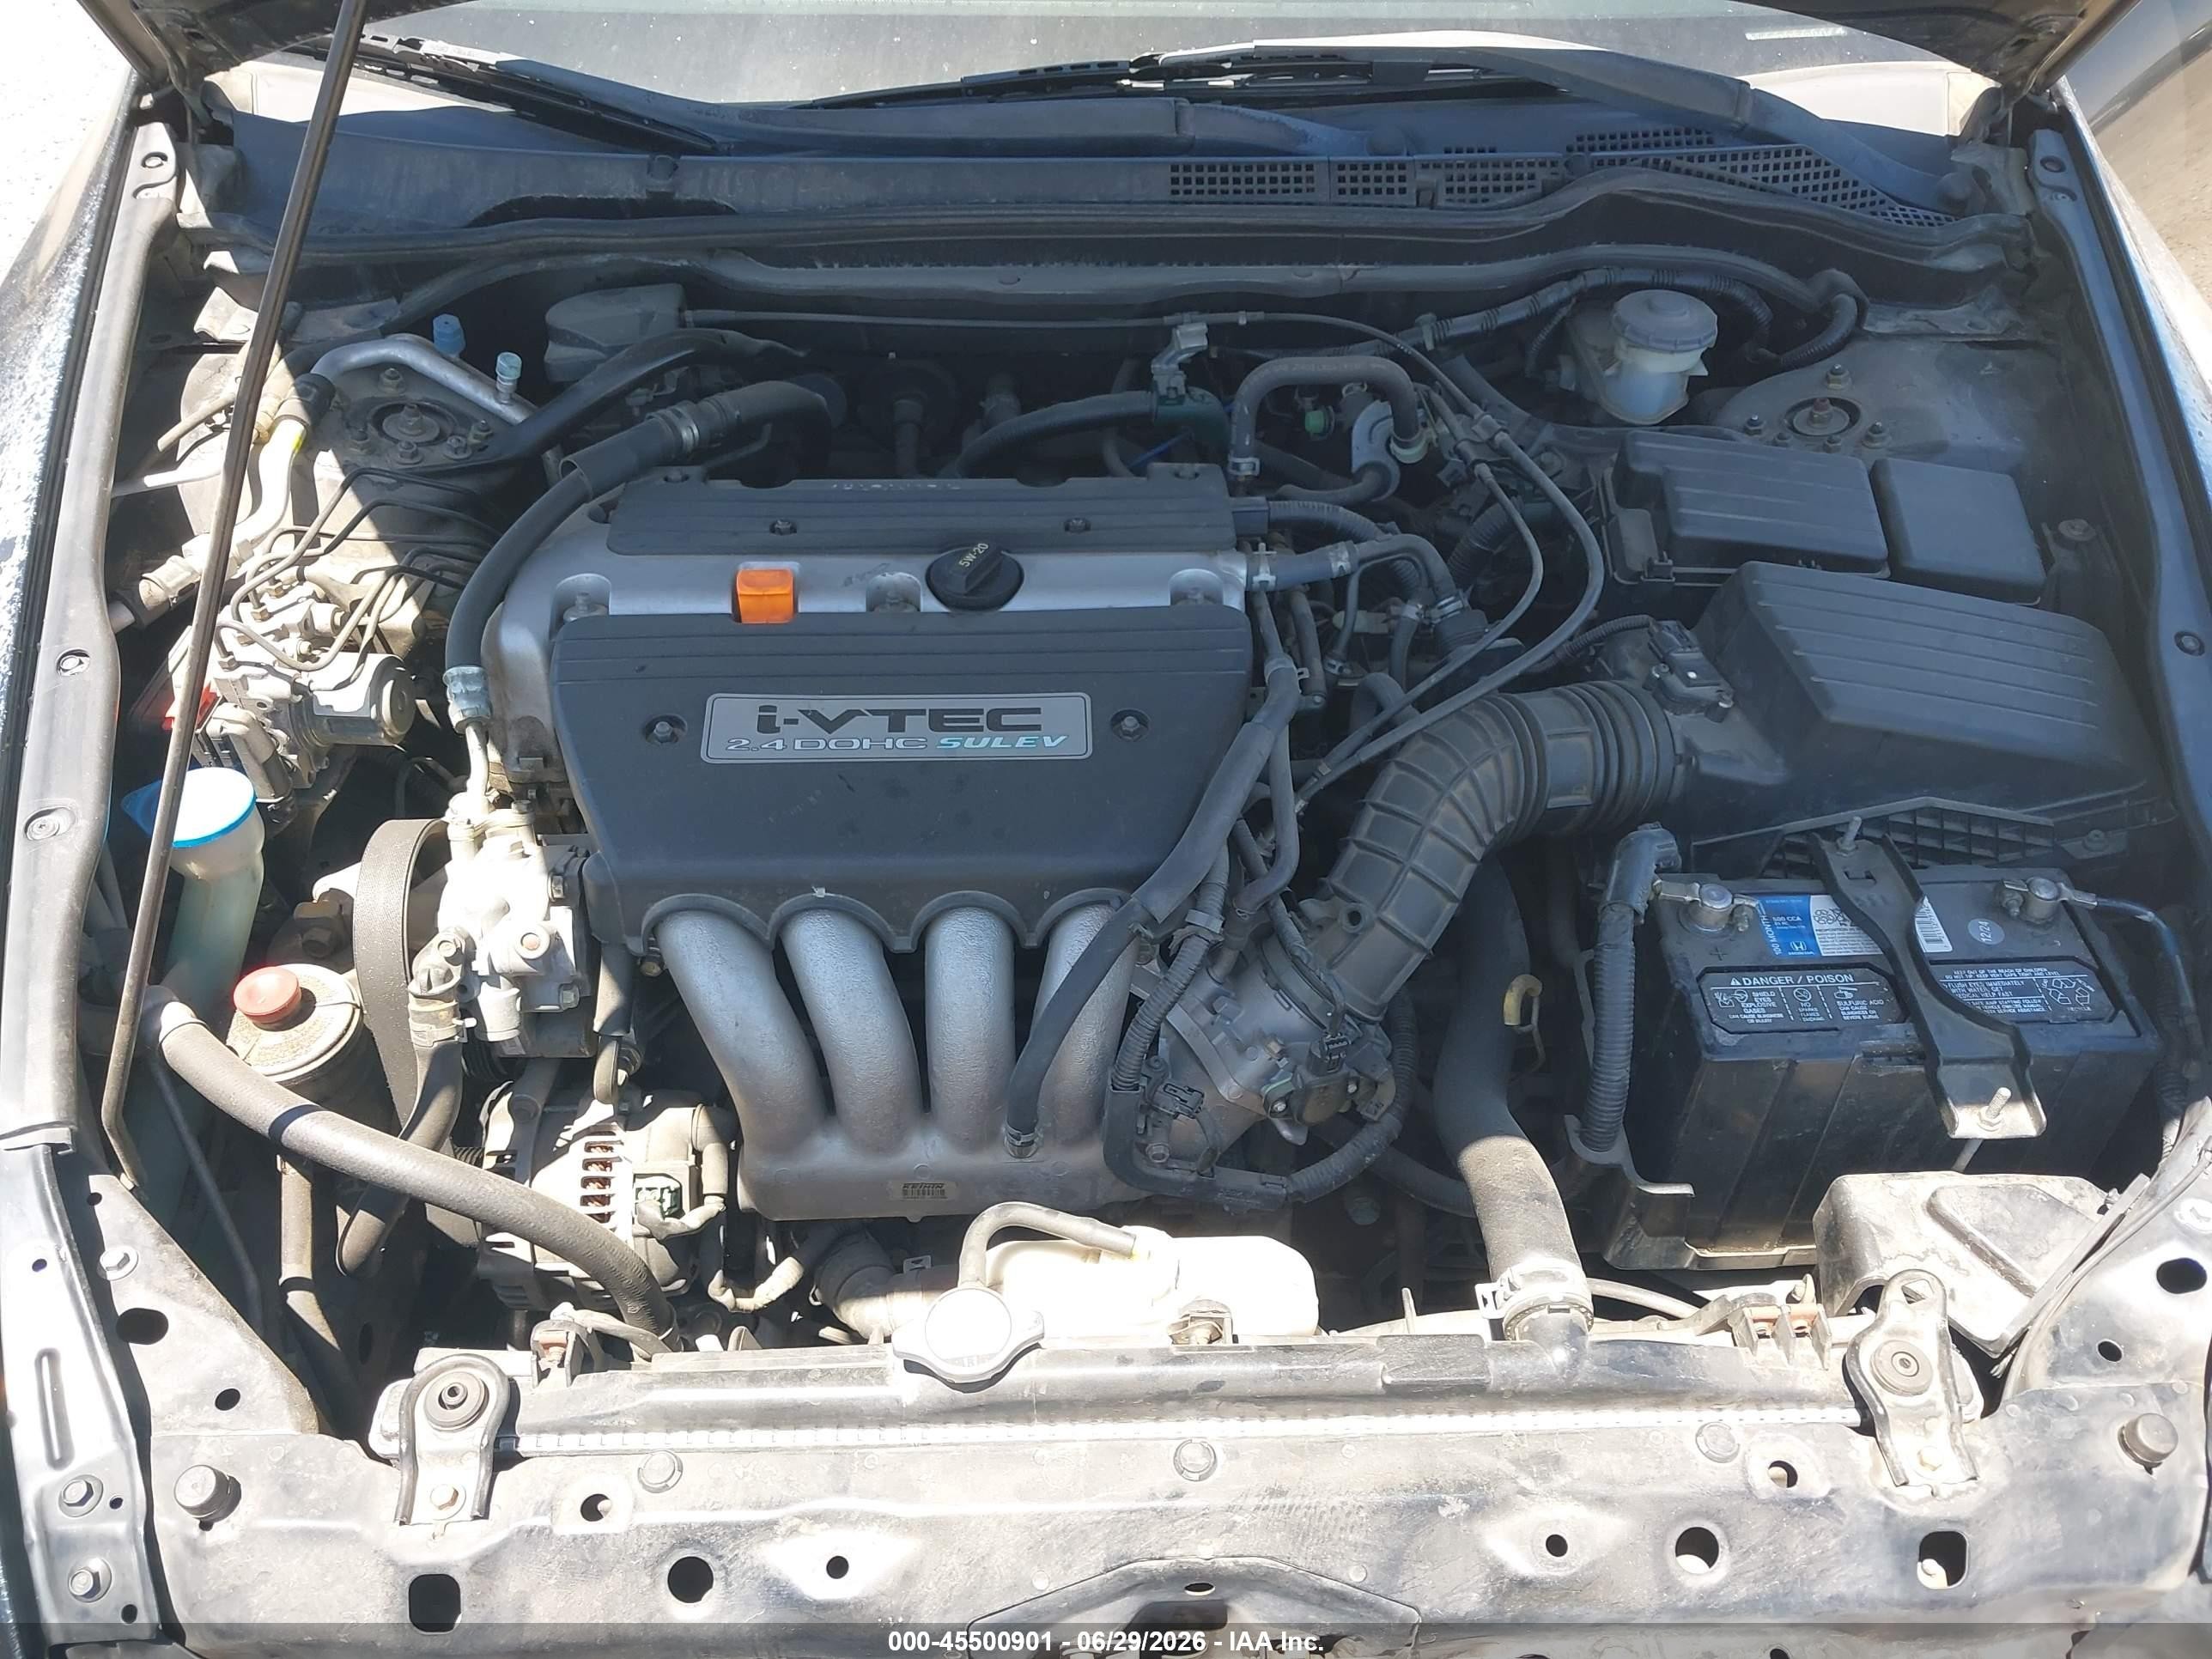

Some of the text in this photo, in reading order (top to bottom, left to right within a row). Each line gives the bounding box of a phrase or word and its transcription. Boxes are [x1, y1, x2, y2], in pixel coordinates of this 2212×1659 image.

[958, 543, 989, 567] 5W-20
[756, 704, 1042, 735] i-VTEC
[726, 734, 1070, 751] 2.4 DOHC SULEV
[1978, 920, 1993, 943] 12/24
[1771, 943, 1784, 956] 100
[1742, 974, 1855, 986] DANGER / POISON
